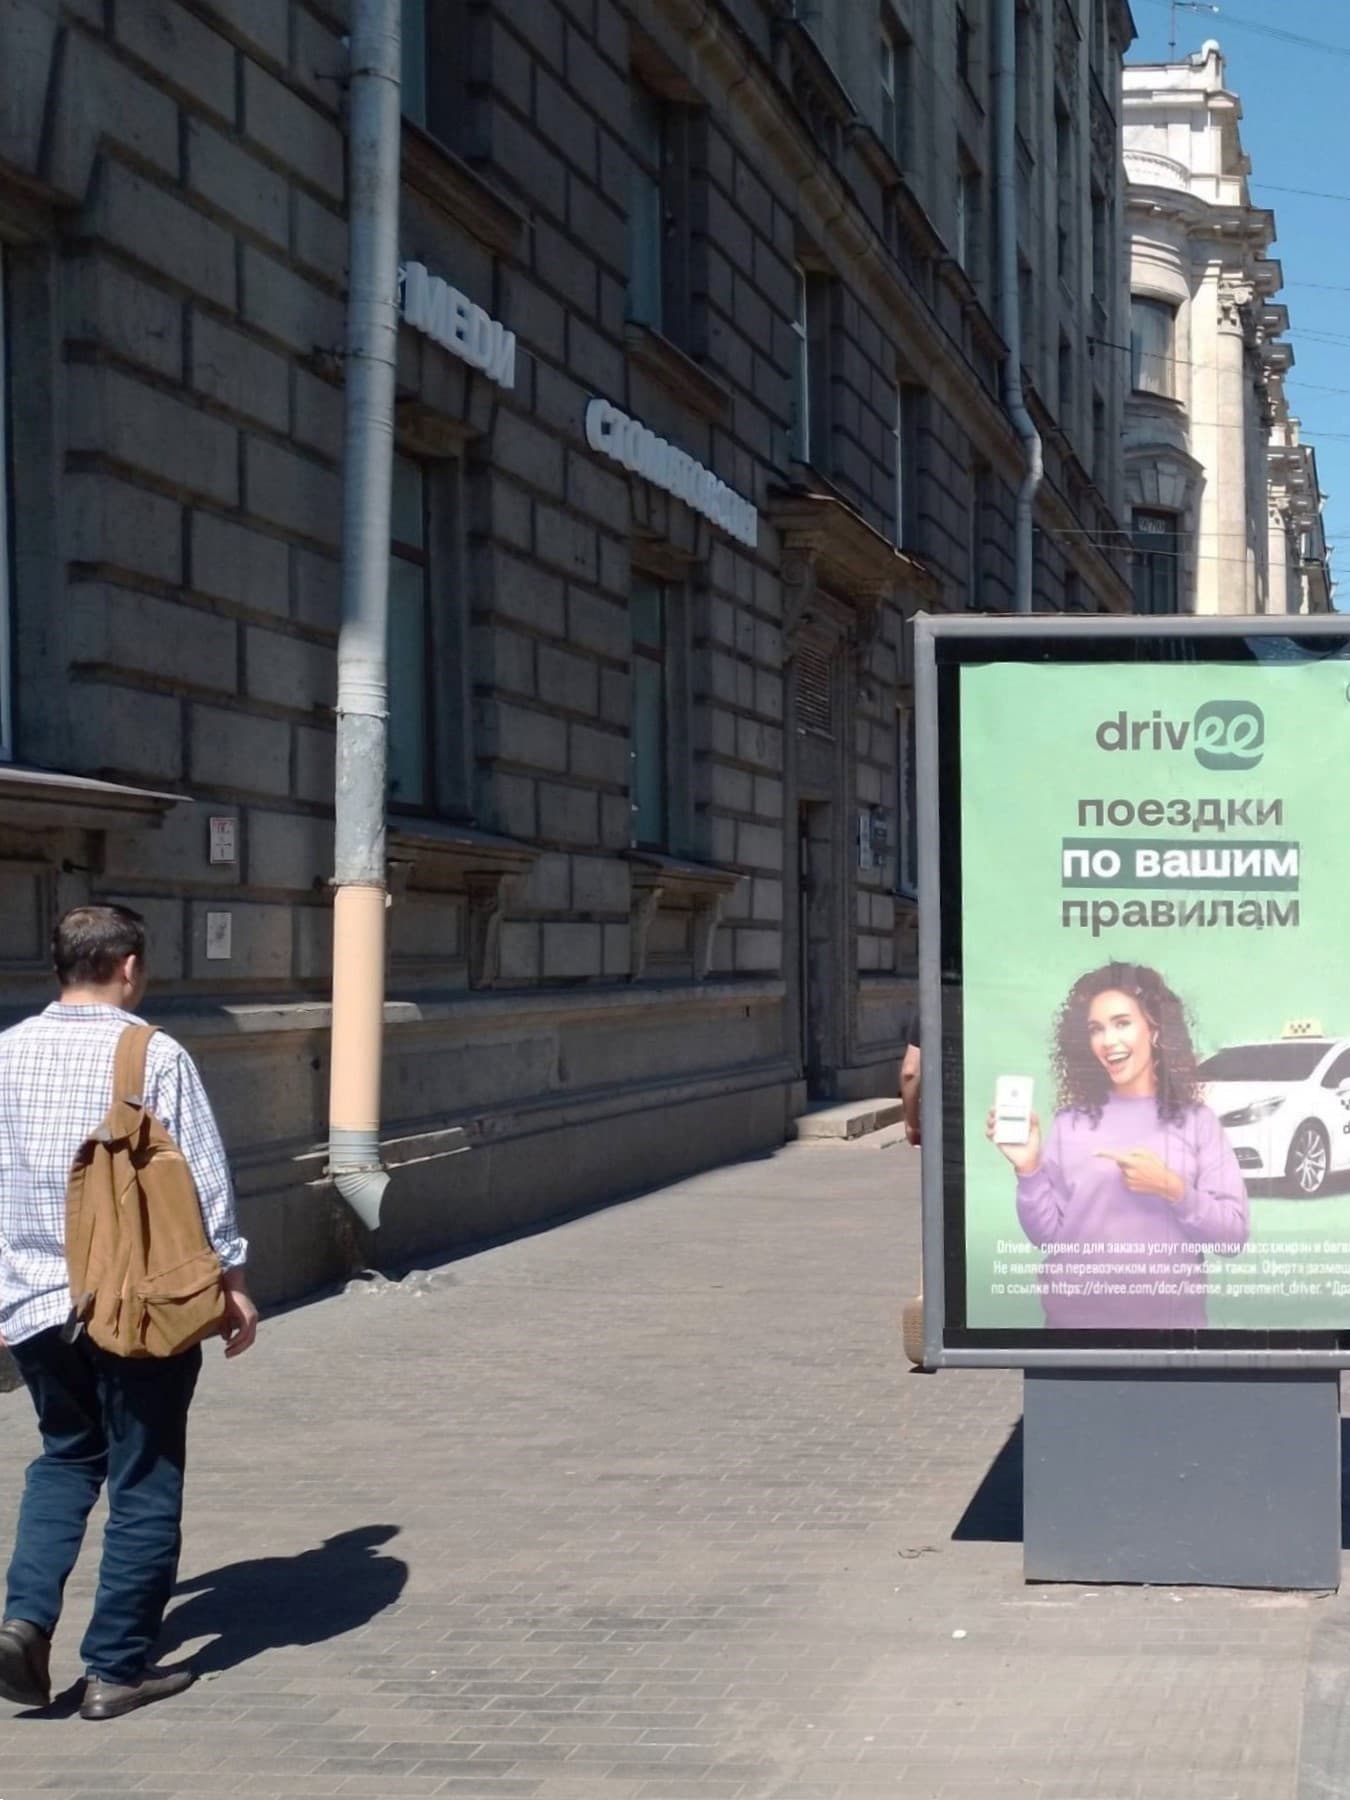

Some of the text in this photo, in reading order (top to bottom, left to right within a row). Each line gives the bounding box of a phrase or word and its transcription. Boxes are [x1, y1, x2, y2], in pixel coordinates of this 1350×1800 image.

[1095, 704, 1265, 762] drivee
[1077, 798, 1283, 833] поездки
[1063, 848, 1298, 879] по вашим
[1062, 899, 1300, 937] правилам
[996, 1240, 1032, 1254] Drivee
[1041, 1242, 1081, 1256] сервис
[1082, 1242, 1105, 1254] для
[1106, 1242, 1146, 1254] заказа
[1147, 1242, 1179, 1256] услуг
[1181, 1242, 1241, 1256] перевозки
[993, 1260, 1008, 1274] Не
[1009, 1263, 1063, 1275] является
[1065, 1263, 1147, 1277] перевозчиком
[1149, 1263, 1171, 1275] или
[1172, 1261, 1222, 1277] службой
[991, 1282, 1005, 1295] по
[1006, 1282, 1050, 1295] ссылке
